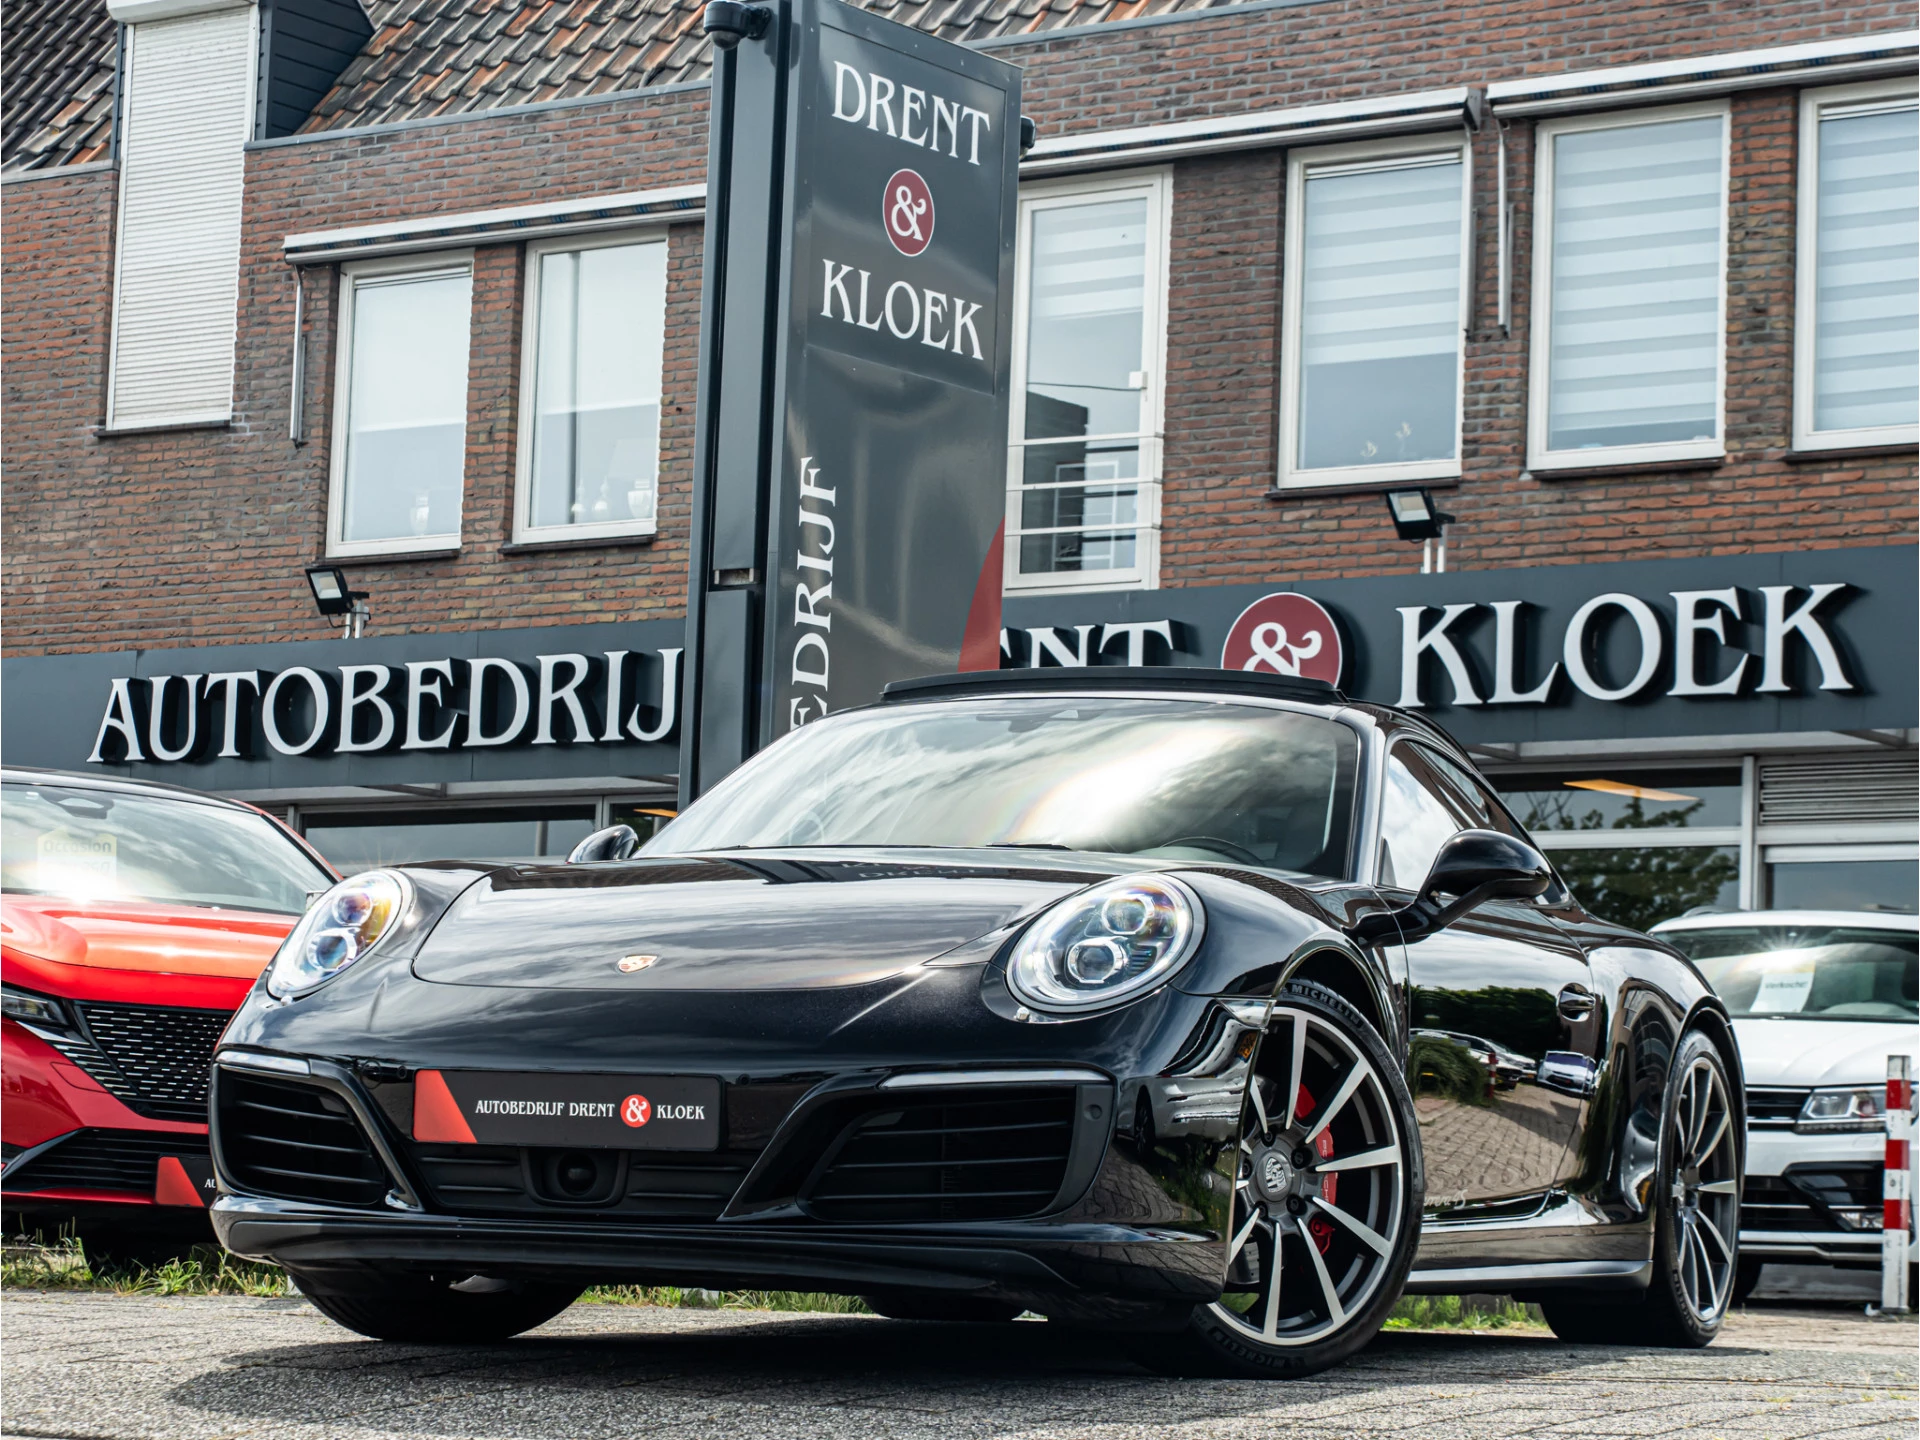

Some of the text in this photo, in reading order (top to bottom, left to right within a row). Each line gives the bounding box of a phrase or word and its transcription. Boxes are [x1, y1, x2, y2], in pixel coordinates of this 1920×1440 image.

[832, 61, 990, 165] DRENT
[891, 185, 926, 241] &
[820, 259, 983, 360] KLOEK
[790, 456, 836, 731] EDRIJF
[86, 648, 684, 763] AUTOBEDRIJ
[1243, 622, 1322, 677] &
[1395, 583, 1855, 707] KLOEK
[43, 838, 112, 853] Occasion
[1292, 984, 1361, 1025] MICHELIN
[475, 1098, 705, 1123] AUTOBEDRIJF DRENT & KLOEK
